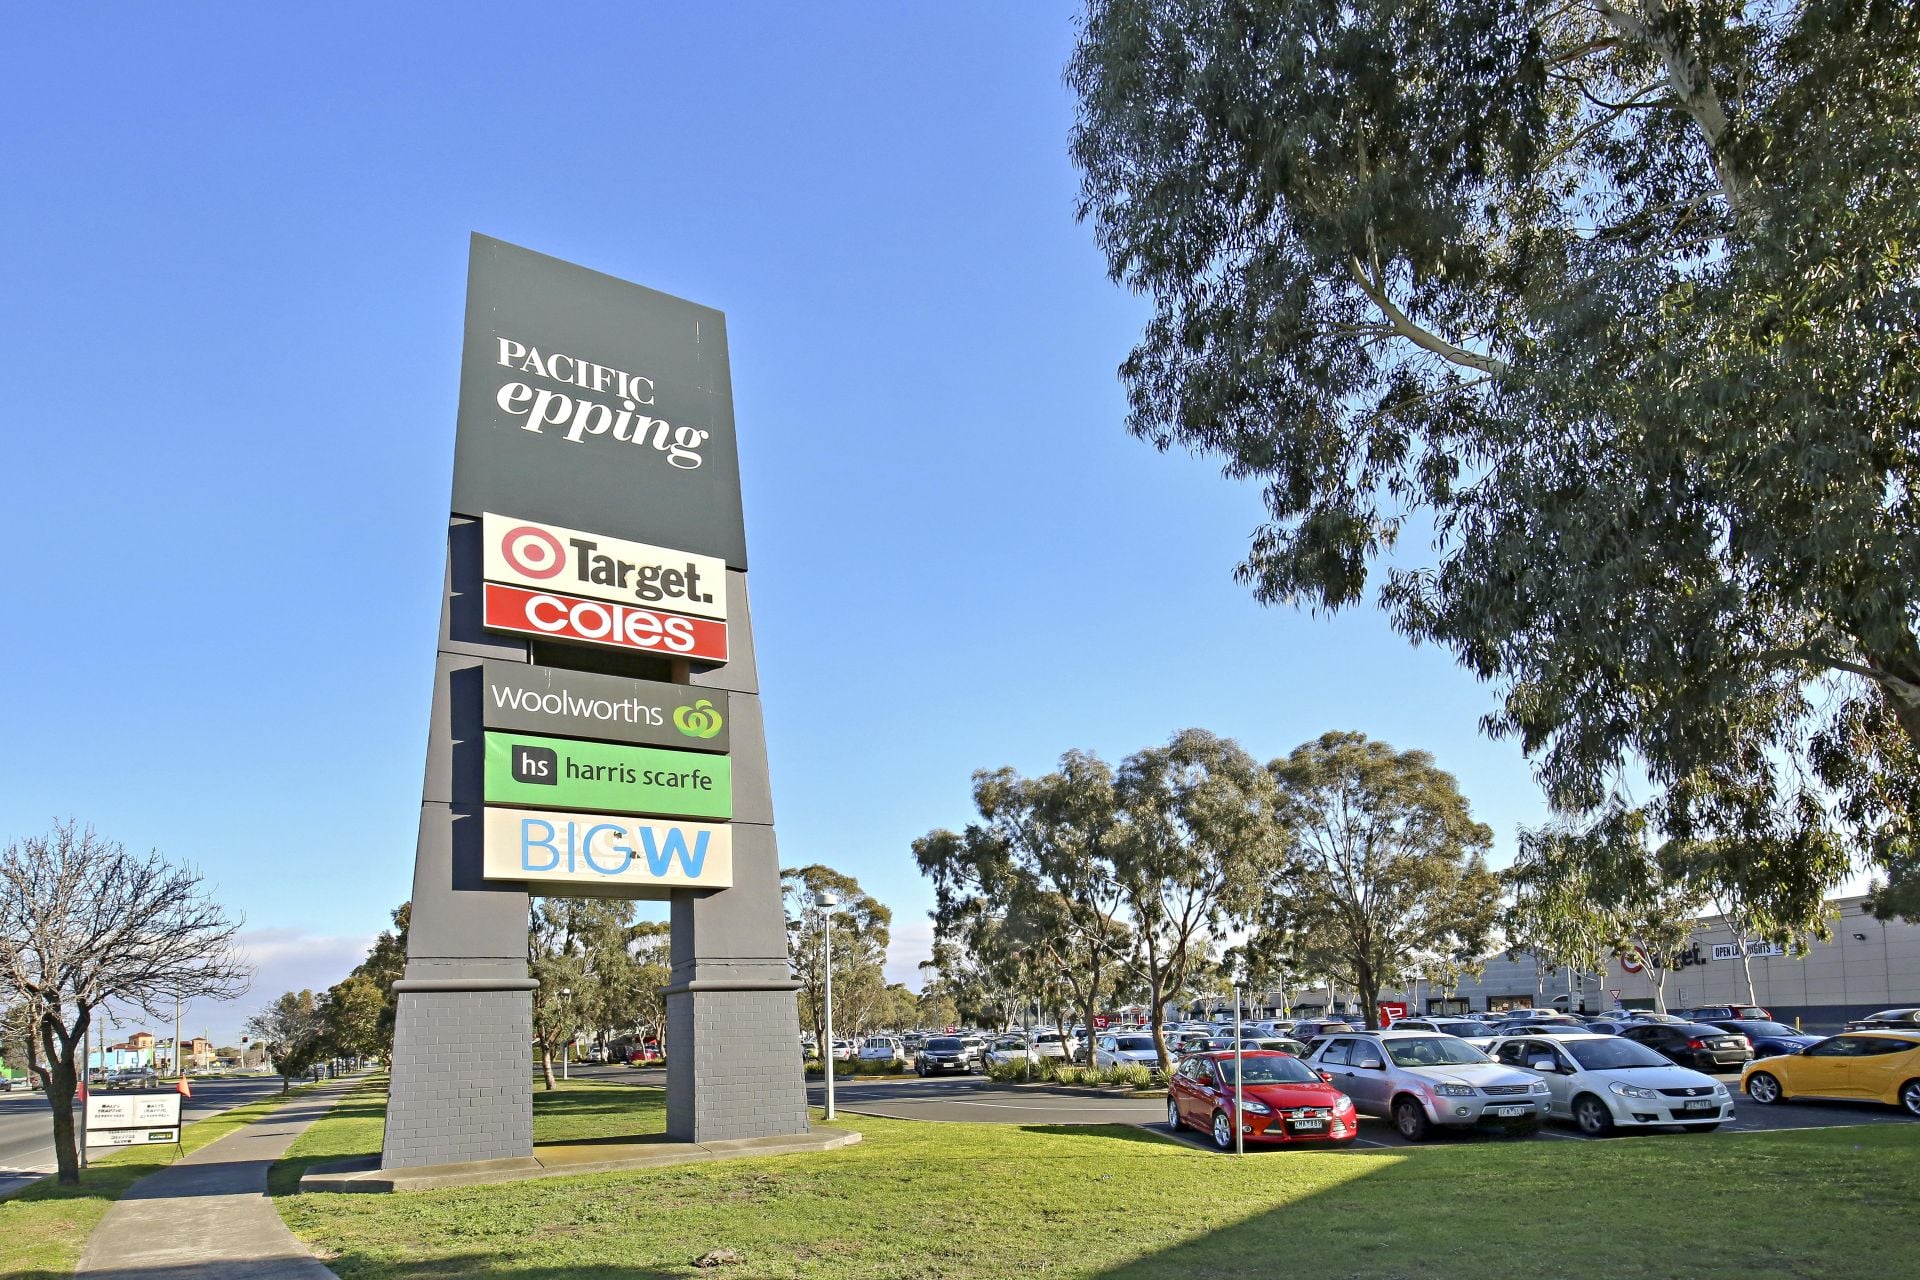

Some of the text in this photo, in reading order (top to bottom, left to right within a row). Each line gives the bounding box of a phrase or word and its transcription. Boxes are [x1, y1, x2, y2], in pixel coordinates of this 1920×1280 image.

[496, 337, 654, 405] PACIFIC
[496, 382, 710, 469] epping
[524, 594, 695, 652] coles
[491, 684, 664, 726] Woolworths
[521, 751, 549, 777] hs
[566, 756, 713, 791] harris scarfe
[1715, 946, 1731, 958] OPEN
